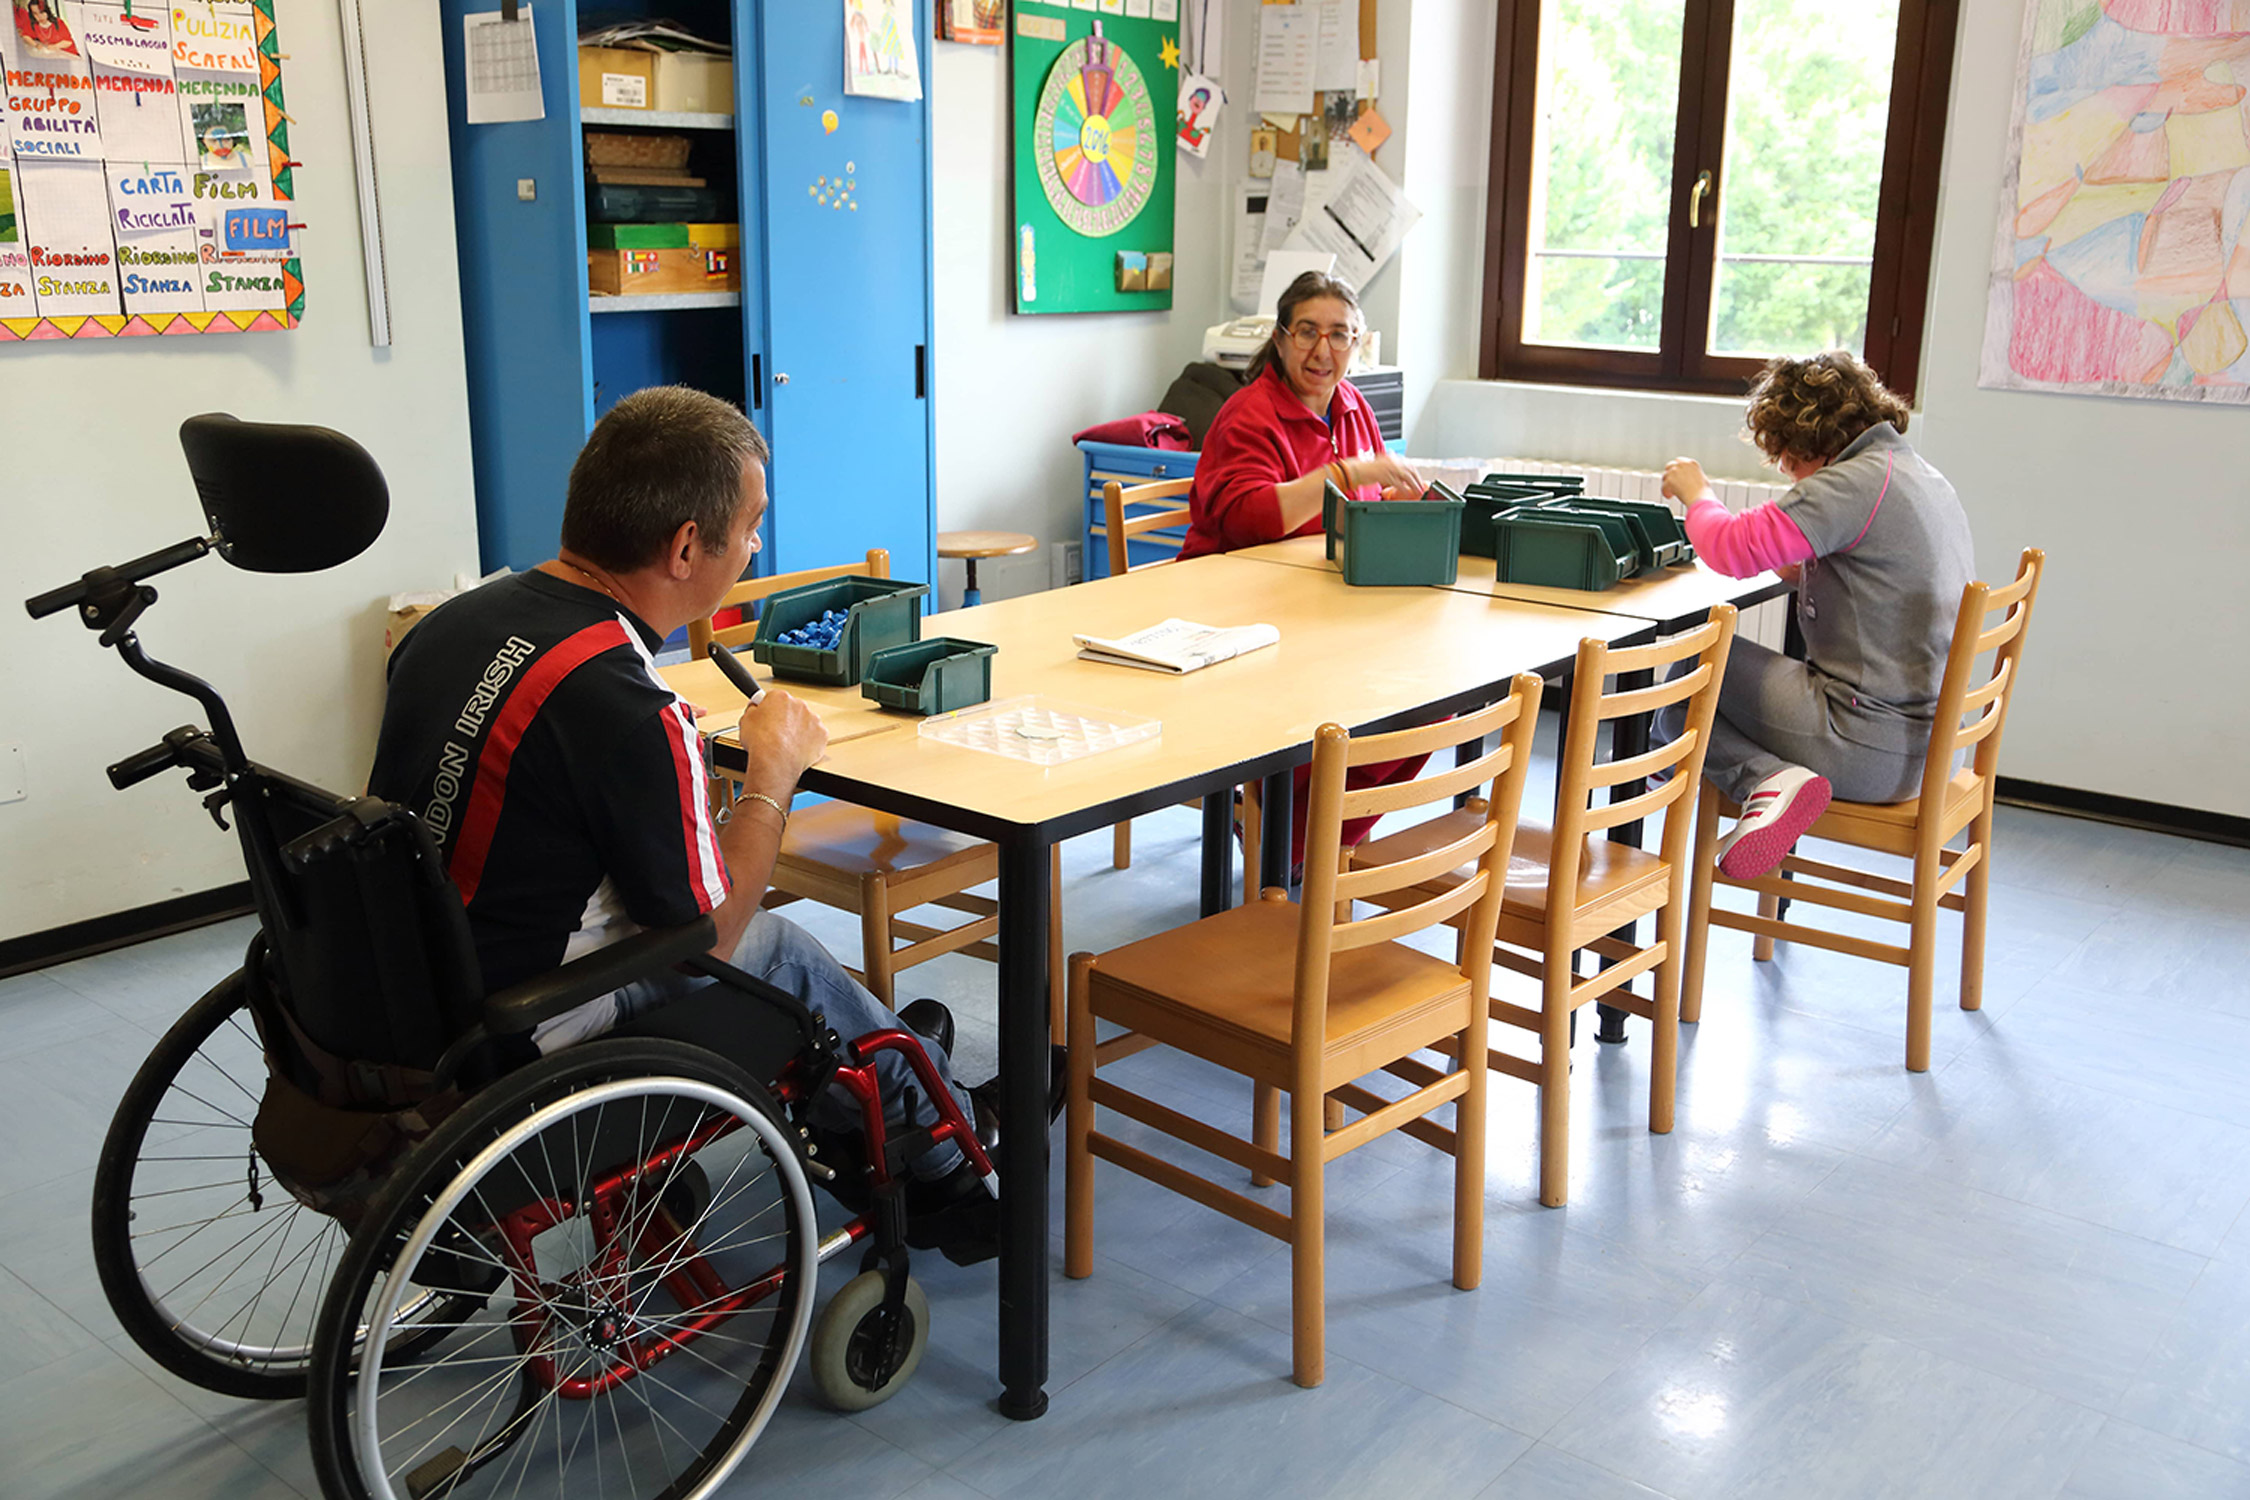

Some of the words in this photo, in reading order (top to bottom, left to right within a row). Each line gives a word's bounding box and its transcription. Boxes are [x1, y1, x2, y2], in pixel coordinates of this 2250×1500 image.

[172, 8, 253, 41] PULIZIA
[7, 70, 92, 90] MERENDA
[96, 75, 175, 94] MERENDA
[179, 80, 260, 97] MERENDA
[8, 96, 81, 115] GRUPPO
[15, 139, 81, 154] SOCIALI
[1084, 126, 1110, 155] 2016
[120, 171, 183, 195] CARTA
[118, 202, 196, 229] RICICLATA
[229, 217, 285, 239] FILM
[38, 275, 110, 296] STANZA
[124, 273, 193, 294] STANZA
[206, 271, 285, 293] STANZA
[455, 635, 536, 738] IRISH
